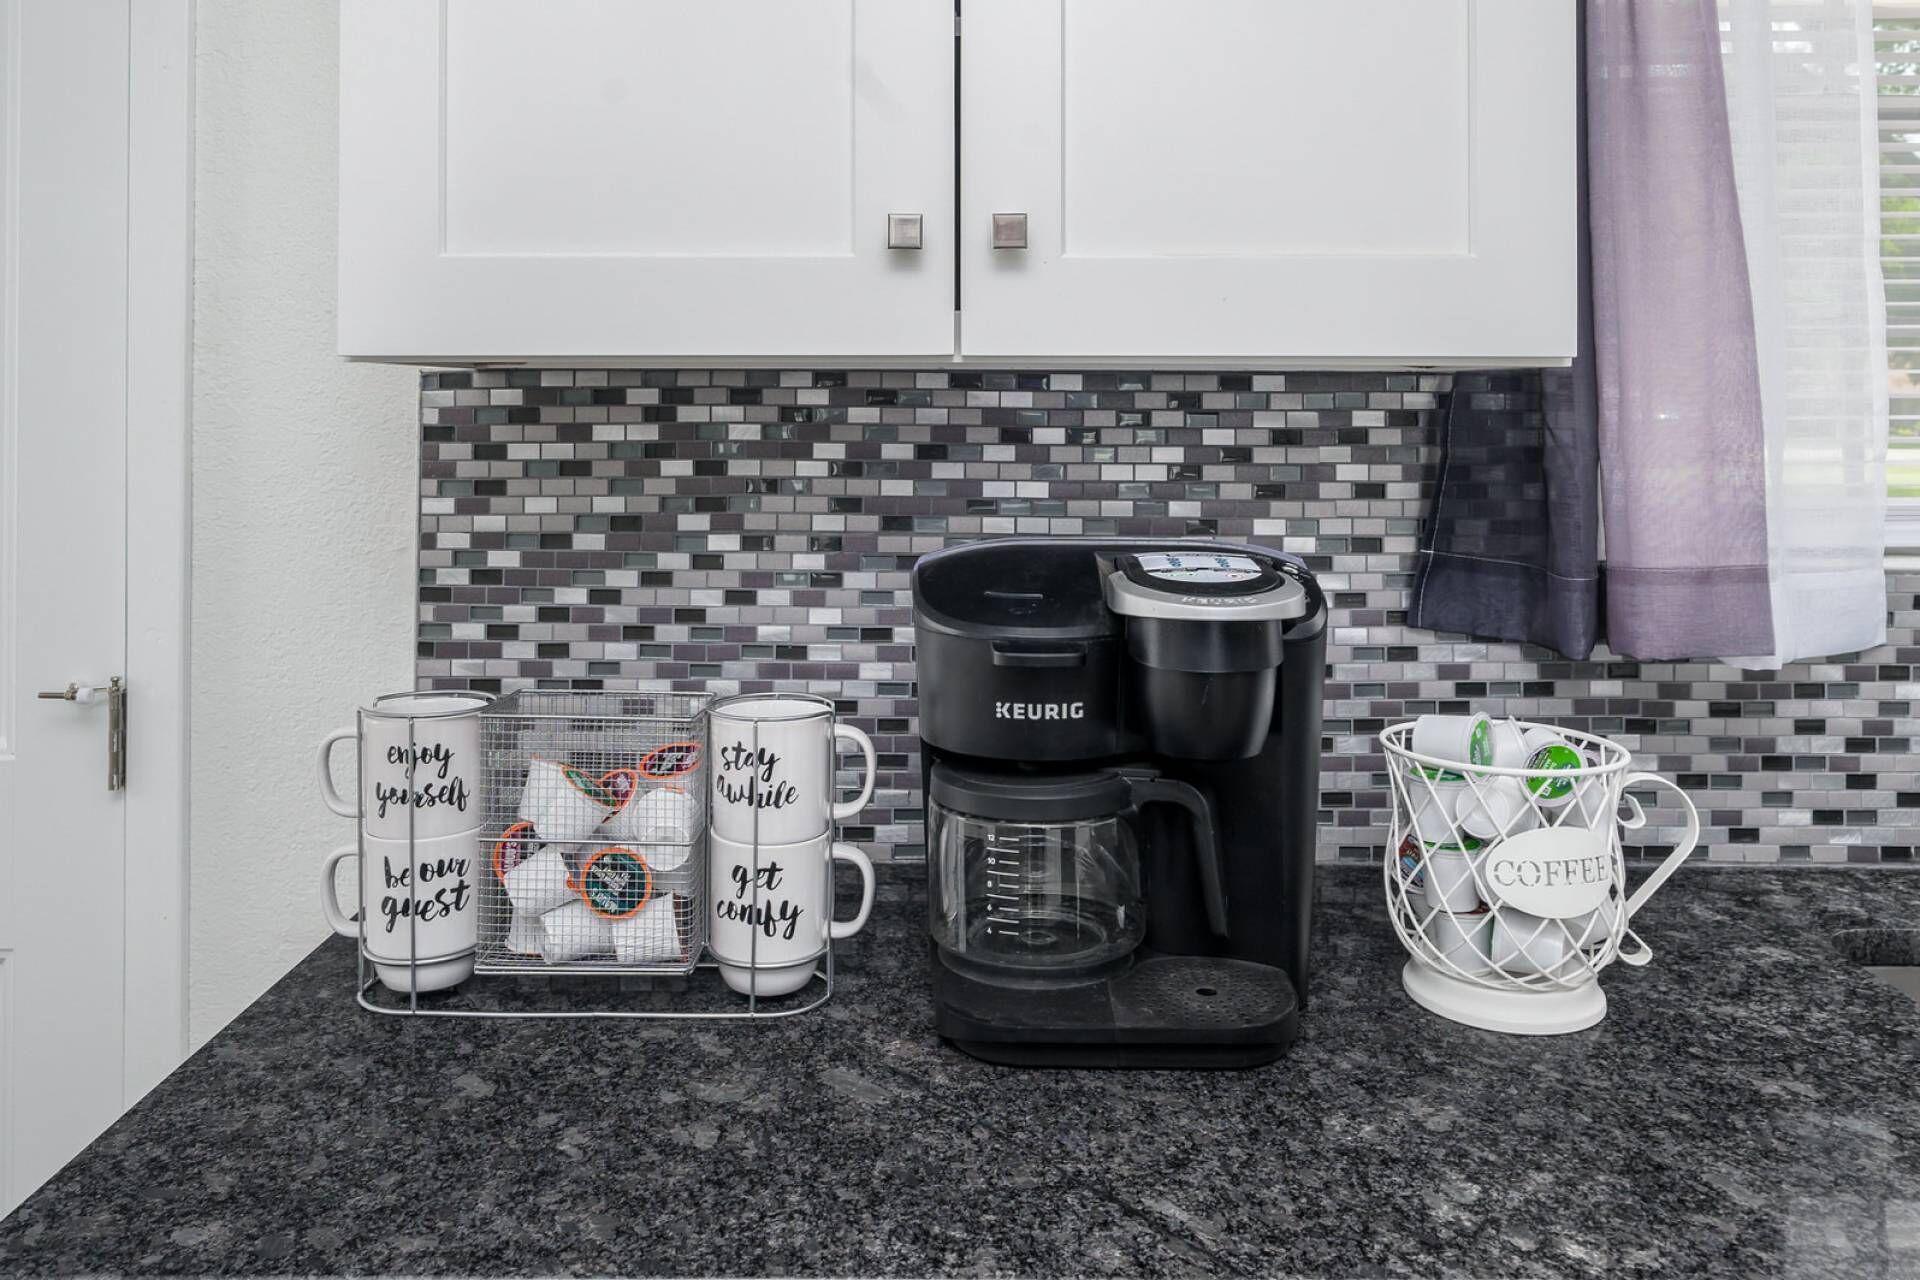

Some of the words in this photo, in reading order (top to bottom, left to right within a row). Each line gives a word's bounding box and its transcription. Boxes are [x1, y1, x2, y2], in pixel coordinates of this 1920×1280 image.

[995, 701, 1084, 720] KEURIG
[387, 742, 455, 779] enjoy
[721, 741, 781, 782] stay
[376, 776, 471, 818] yourself
[384, 855, 411, 889] be
[419, 857, 471, 883] our
[987, 857, 996, 865] 10
[1493, 854, 1610, 888] COFFEE
[731, 861, 783, 900] get
[381, 879, 471, 933] guest
[716, 899, 804, 940] comfy
